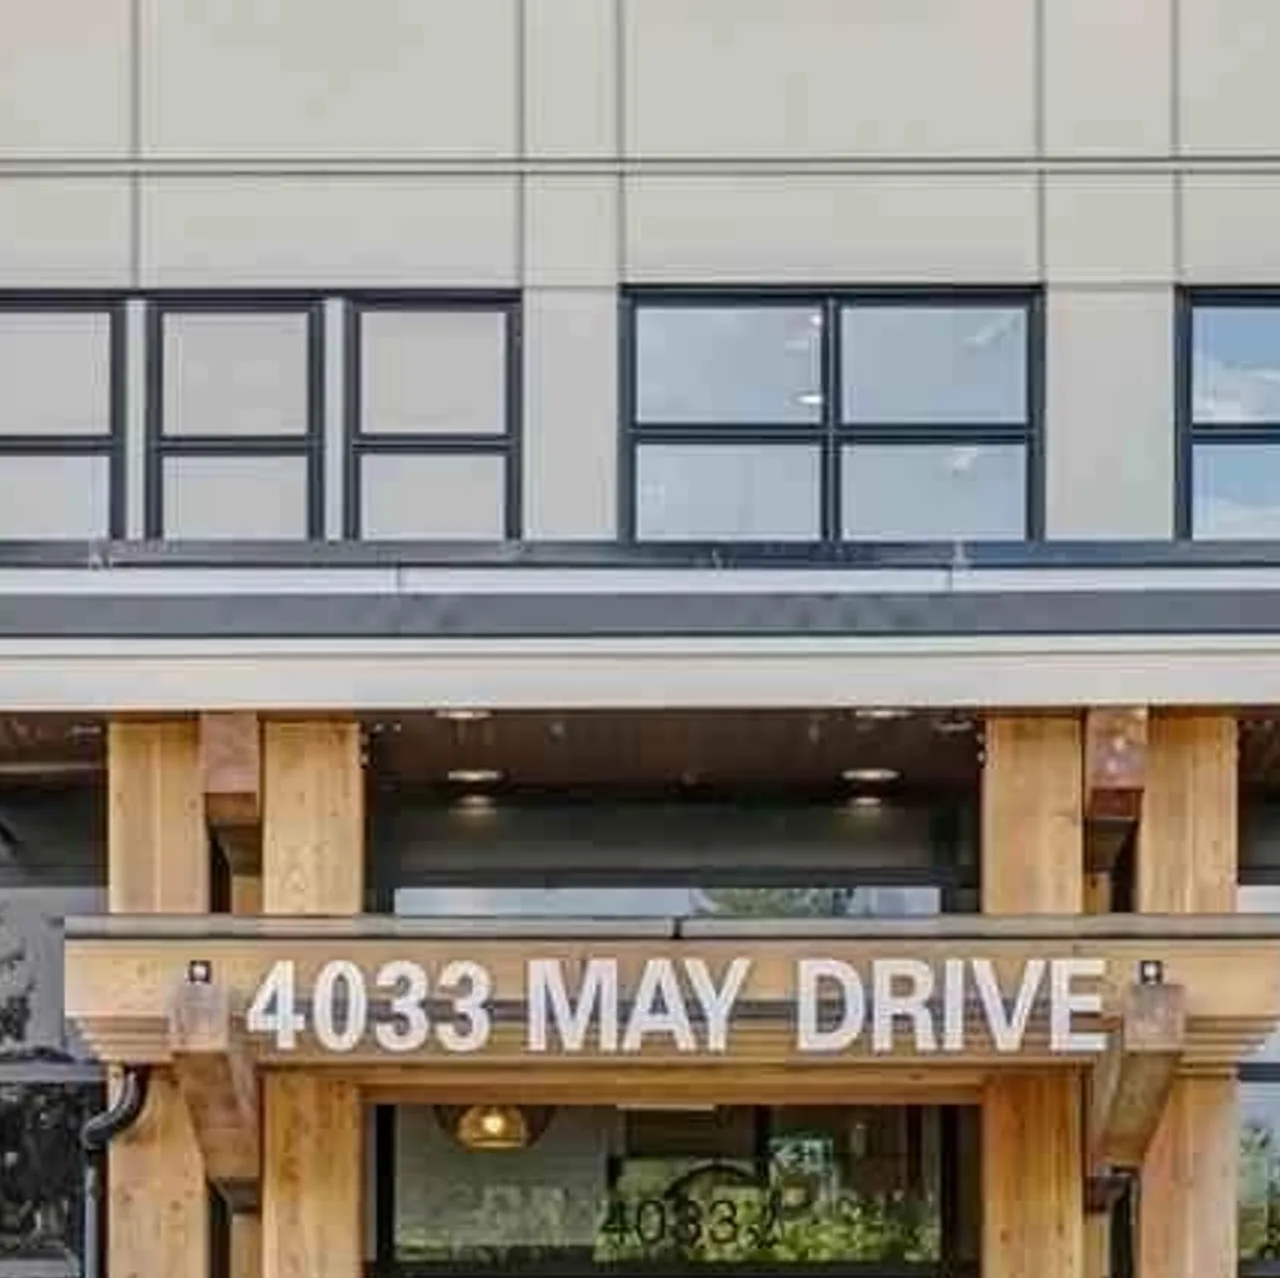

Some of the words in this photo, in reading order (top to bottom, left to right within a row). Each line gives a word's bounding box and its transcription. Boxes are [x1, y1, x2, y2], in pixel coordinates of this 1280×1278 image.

[246, 959, 492, 1052] 4033
[526, 957, 752, 1051] MAY
[796, 959, 1108, 1051] DRIVE
